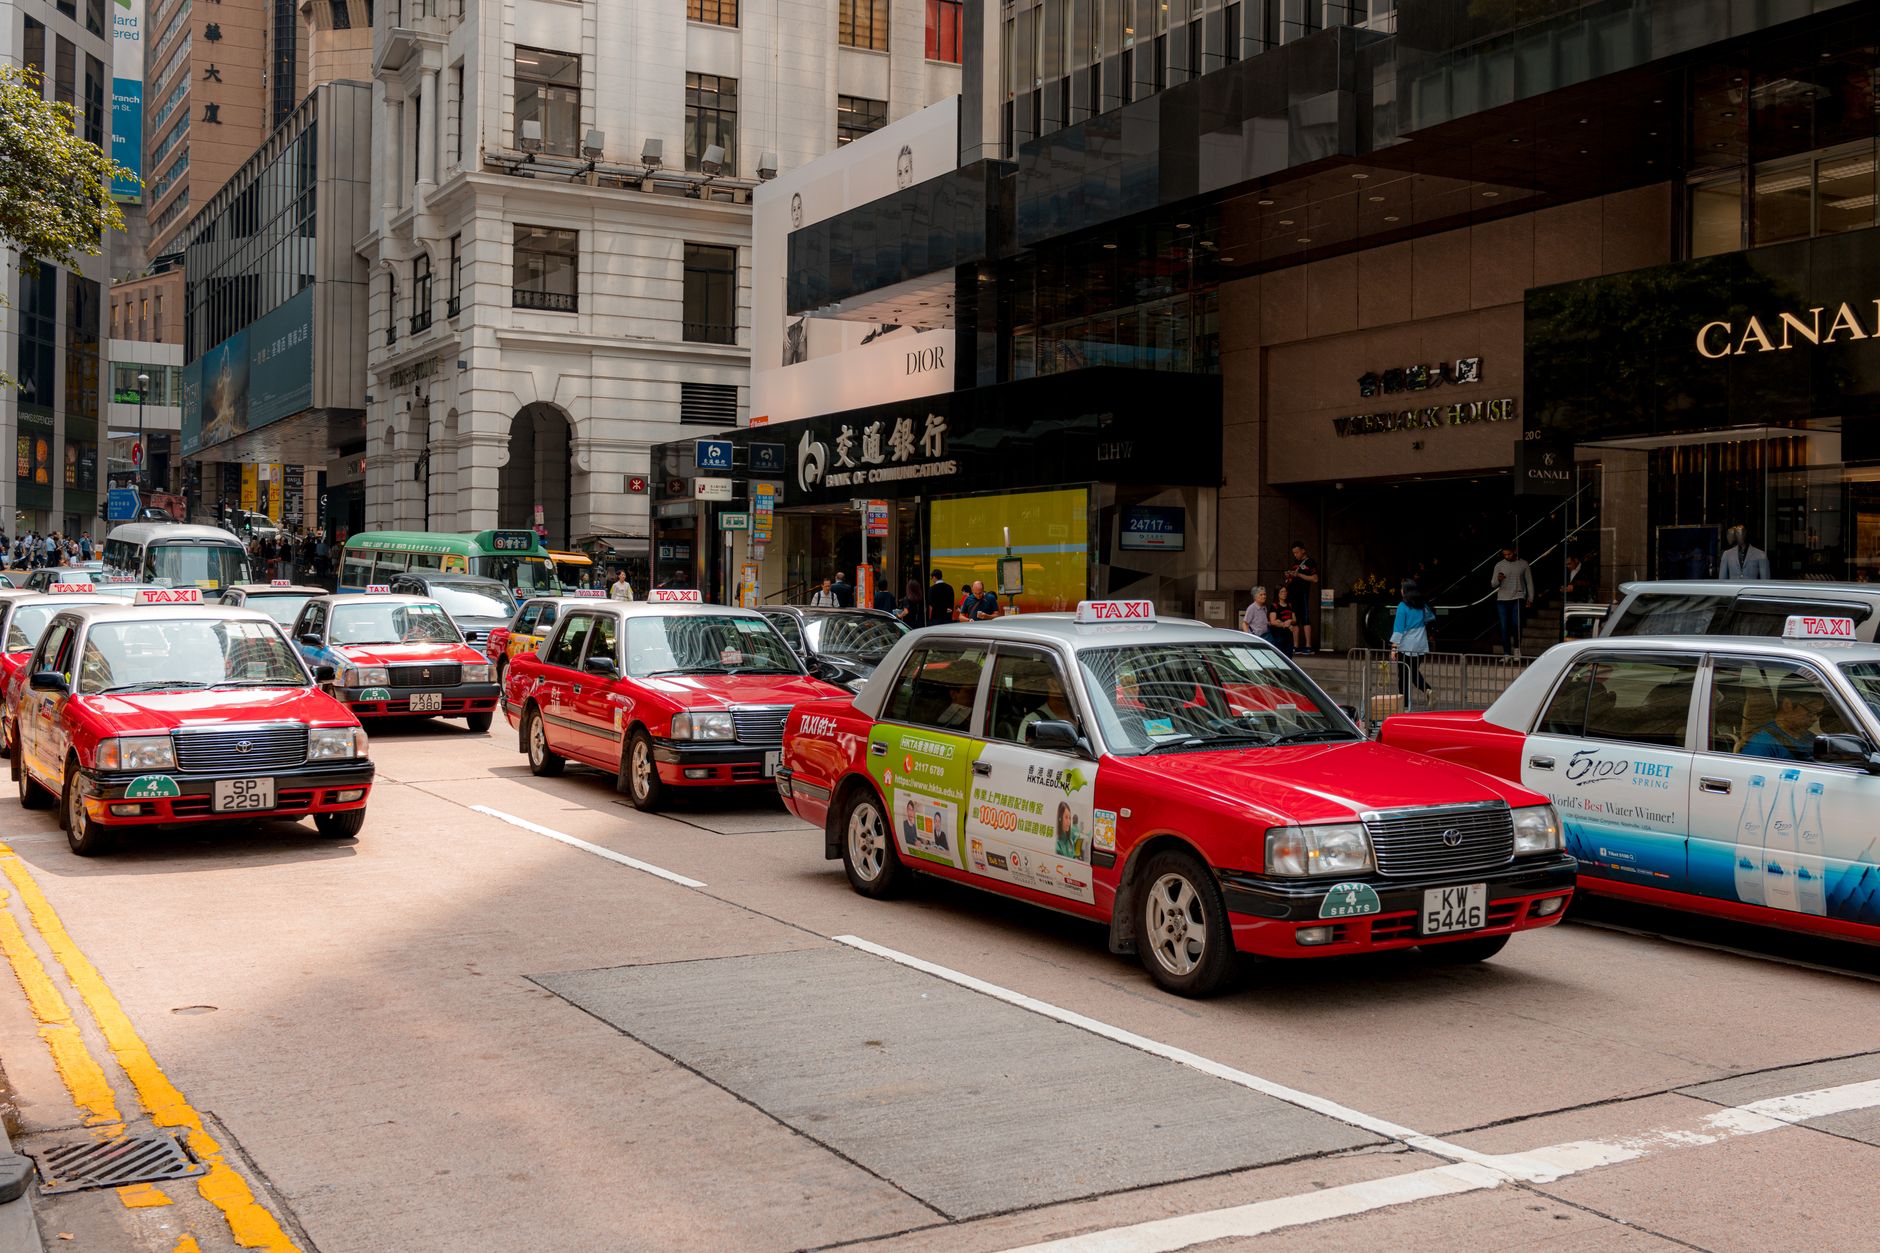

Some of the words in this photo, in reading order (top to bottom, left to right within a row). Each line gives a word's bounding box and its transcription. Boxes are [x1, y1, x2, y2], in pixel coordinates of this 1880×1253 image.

[905, 346, 945, 376] DIOR
[1333, 406, 1443, 438] WHEELOCK
[1447, 398, 1515, 426] HOUSE
[833, 412, 948, 468] 交通銀行
[825, 473, 851, 488] BANK
[852, 469, 867, 485] OF
[868, 460, 957, 483] COMMUNICATIONS
[1528, 468, 1569, 480] CANALI
[54, 584, 93, 593] TAXI
[142, 590, 198, 602] TAXI
[369, 585, 389, 593] TAXI
[656, 590, 698, 601] TAXI
[1091, 602, 1150, 619] TAXI
[1803, 617, 1851, 635] TAXI
[411, 702, 440, 711] 7380
[914, 761, 929, 774] 2117
[1565, 748, 1629, 786] 5100
[1633, 760, 1673, 779] TIBET
[147, 780, 158, 791] 4
[233, 780, 257, 795] SP
[1027, 774, 1070, 791] HKTA.EDU.HK
[1631, 777, 1670, 791] SPRING
[223, 794, 268, 809] 2291
[1583, 799, 1604, 813] Best
[1605, 802, 1634, 818] Water
[1634, 806, 1675, 824] Winner!
[1337, 883, 1364, 893] TAXI
[1345, 890, 1357, 905] 4
[1442, 887, 1468, 910] KW
[1330, 904, 1370, 916] SEATS
[1428, 906, 1481, 932] 5446
